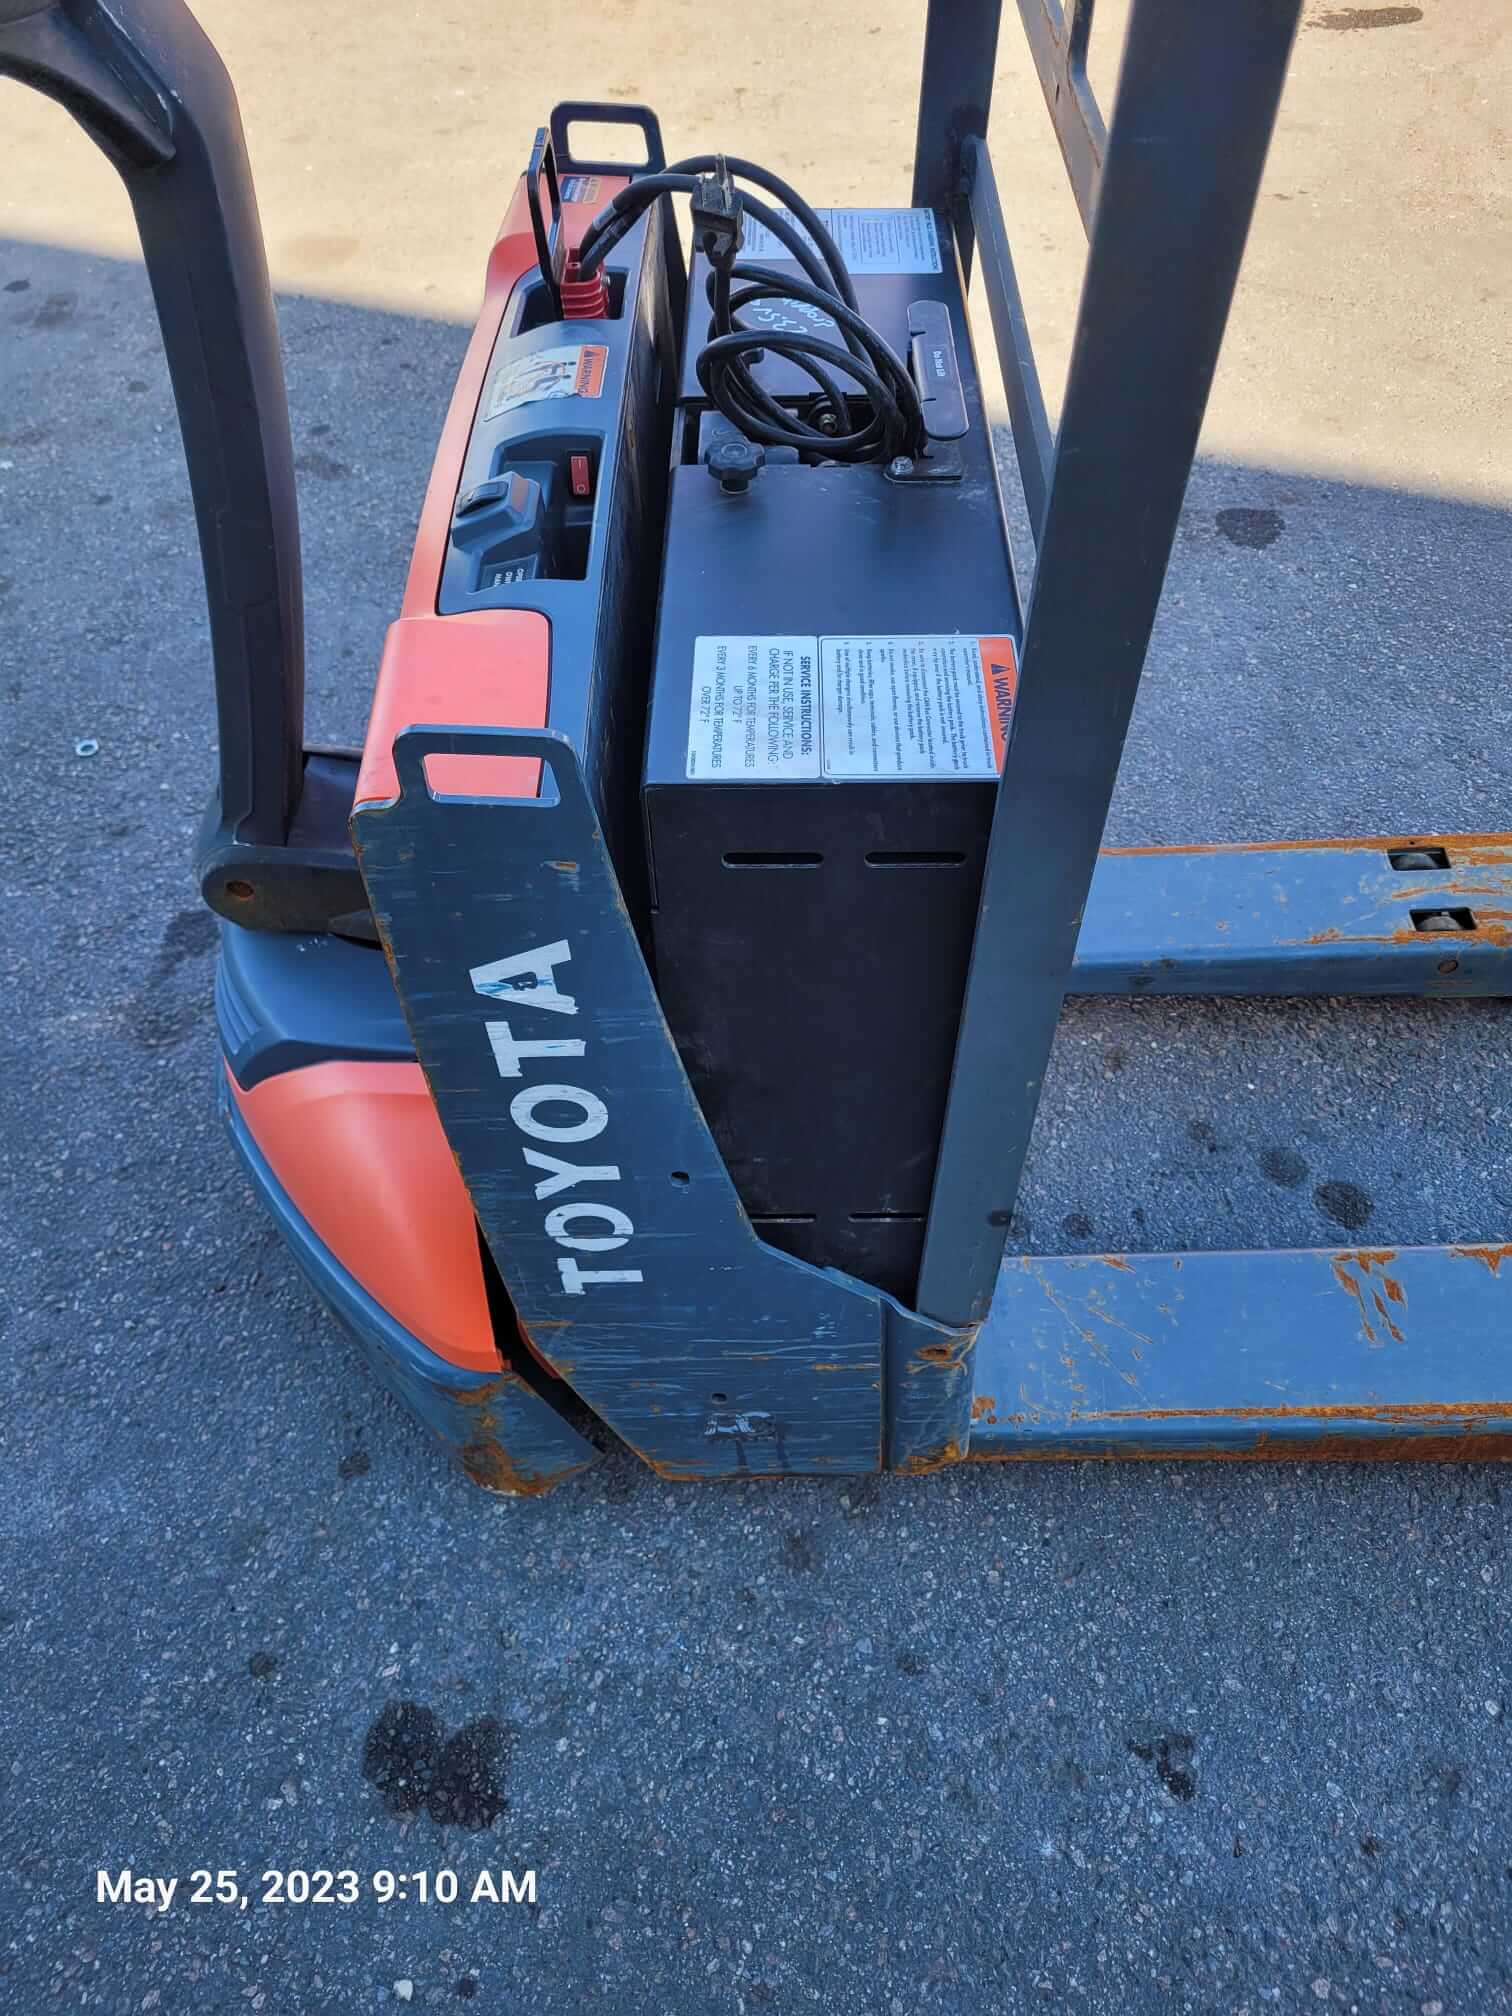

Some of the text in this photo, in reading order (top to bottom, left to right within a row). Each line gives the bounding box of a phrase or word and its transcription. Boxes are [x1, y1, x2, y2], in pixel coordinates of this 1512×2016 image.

[578, 358, 593, 393] WARNING
[717, 646, 727, 664] EVERY
[748, 646, 757, 664] EVERY
[768, 648, 779, 679] CHARGE
[782, 659, 793, 676] NOT
[715, 672, 725, 701] MONTHS
[734, 686, 743, 694] UP
[747, 672, 757, 701] MONTHS
[768, 681, 779, 694] PER
[782, 677, 793, 685] IN
[701, 686, 711, 704] OVER
[732, 696, 743, 705] TO
[768, 696, 779, 710] THE
[714, 703, 725, 716] FOR
[746, 703, 756, 716] FOR
[800, 656, 812, 756] SERVICE INSTRUCTIONS:
[782, 706, 793, 738] SERVICE
[712, 718, 724, 768] TEMPERATURES
[745, 718, 756, 768] TEMPERATURES
[783, 739, 793, 759] AND
[469, 939, 644, 1295] TOYOTA
